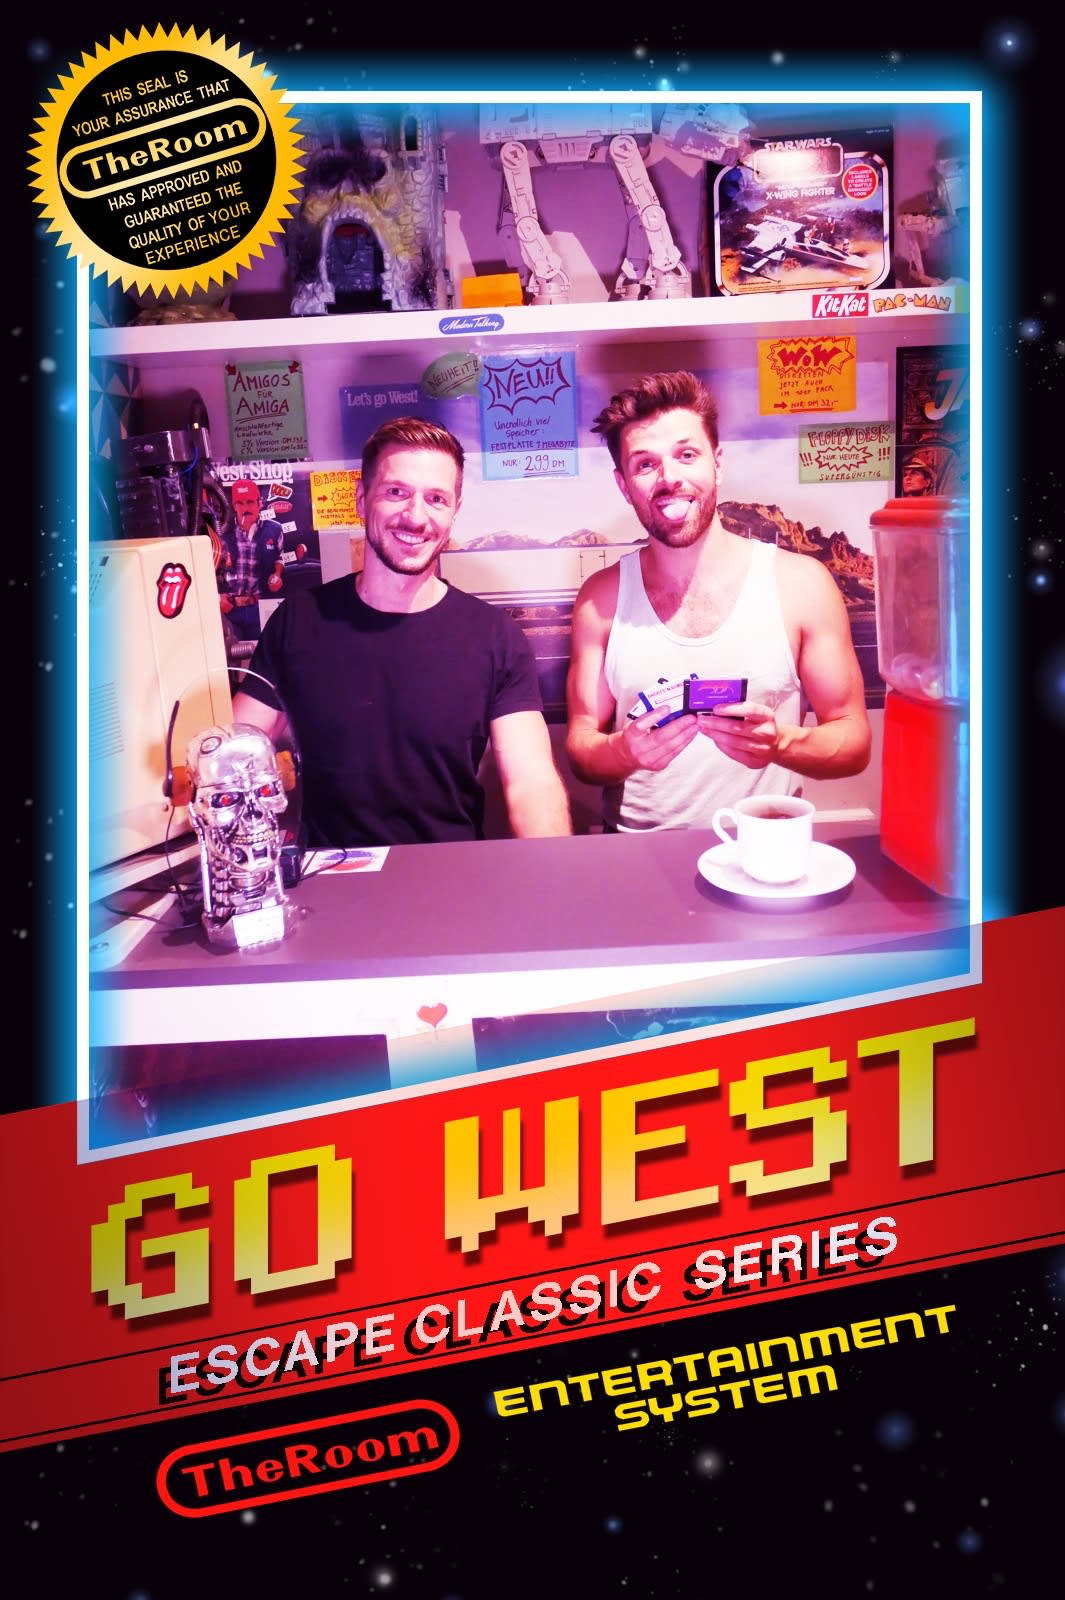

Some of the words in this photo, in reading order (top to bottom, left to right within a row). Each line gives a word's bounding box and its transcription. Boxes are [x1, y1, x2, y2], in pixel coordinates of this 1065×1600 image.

[764, 141, 797, 151] STAR
[795, 137, 832, 150] WARS
[801, 186, 835, 197] FIGHTER
[873, 293, 952, 313] PAC-MAN
[442, 318, 474, 331] Modern
[233, 371, 291, 393] AMIGOS
[257, 389, 273, 398] FÜR
[347, 392, 373, 407] Let's
[374, 394, 387, 408] go
[388, 390, 418, 405] West!
[236, 397, 290, 416] AMIGA
[808, 427, 855, 447] FLOPPY
[525, 454, 550, 471] 299
[553, 460, 565, 468] DM
